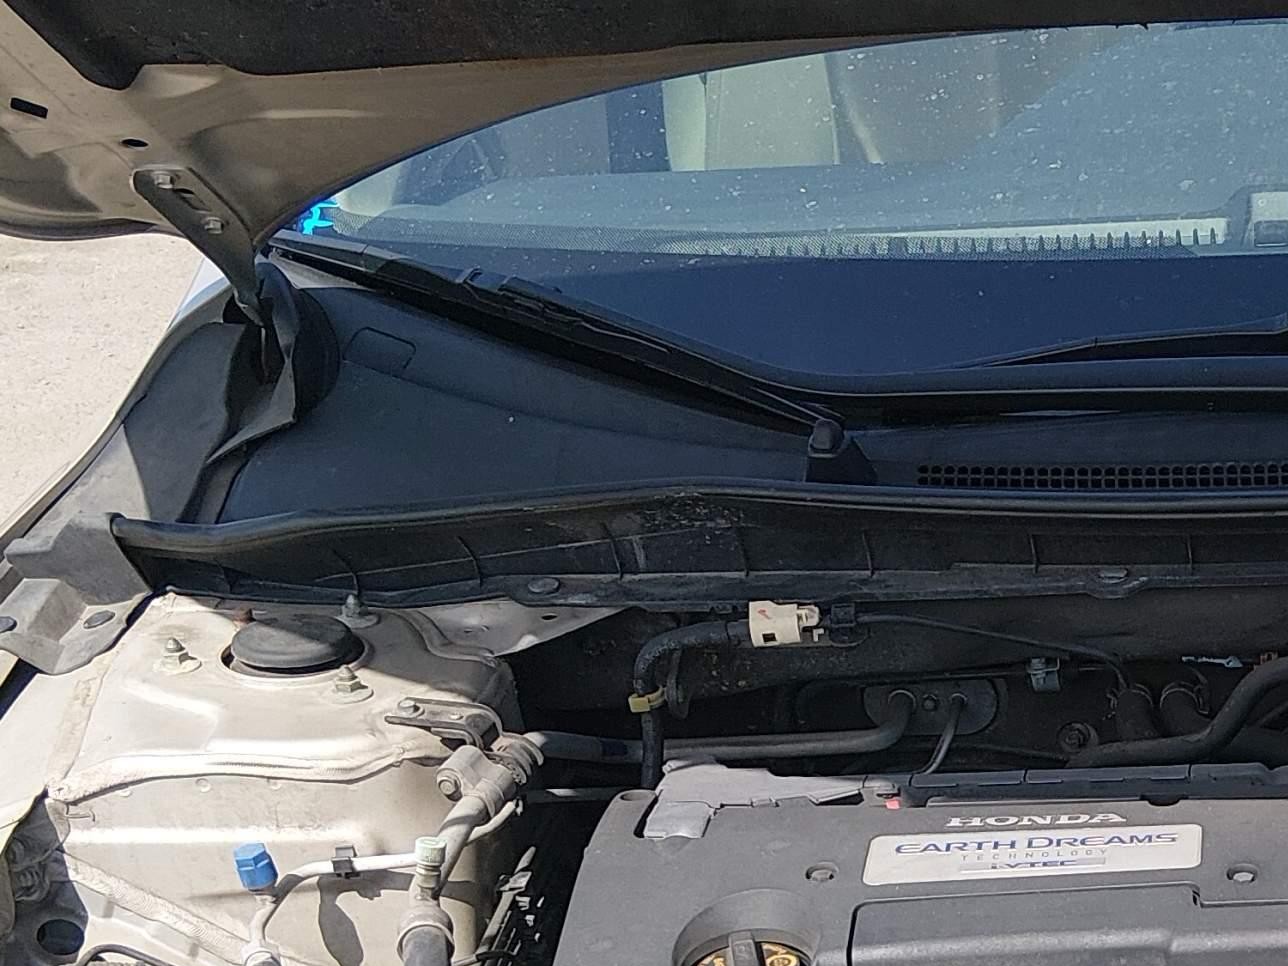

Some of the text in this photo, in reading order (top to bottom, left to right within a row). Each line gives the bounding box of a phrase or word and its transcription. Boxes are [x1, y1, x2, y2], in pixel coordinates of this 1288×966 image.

[946, 813, 1127, 827] HONDA
[895, 833, 1177, 854] EARTH DREAMS
[961, 849, 1108, 861] TECHNOLOGY
